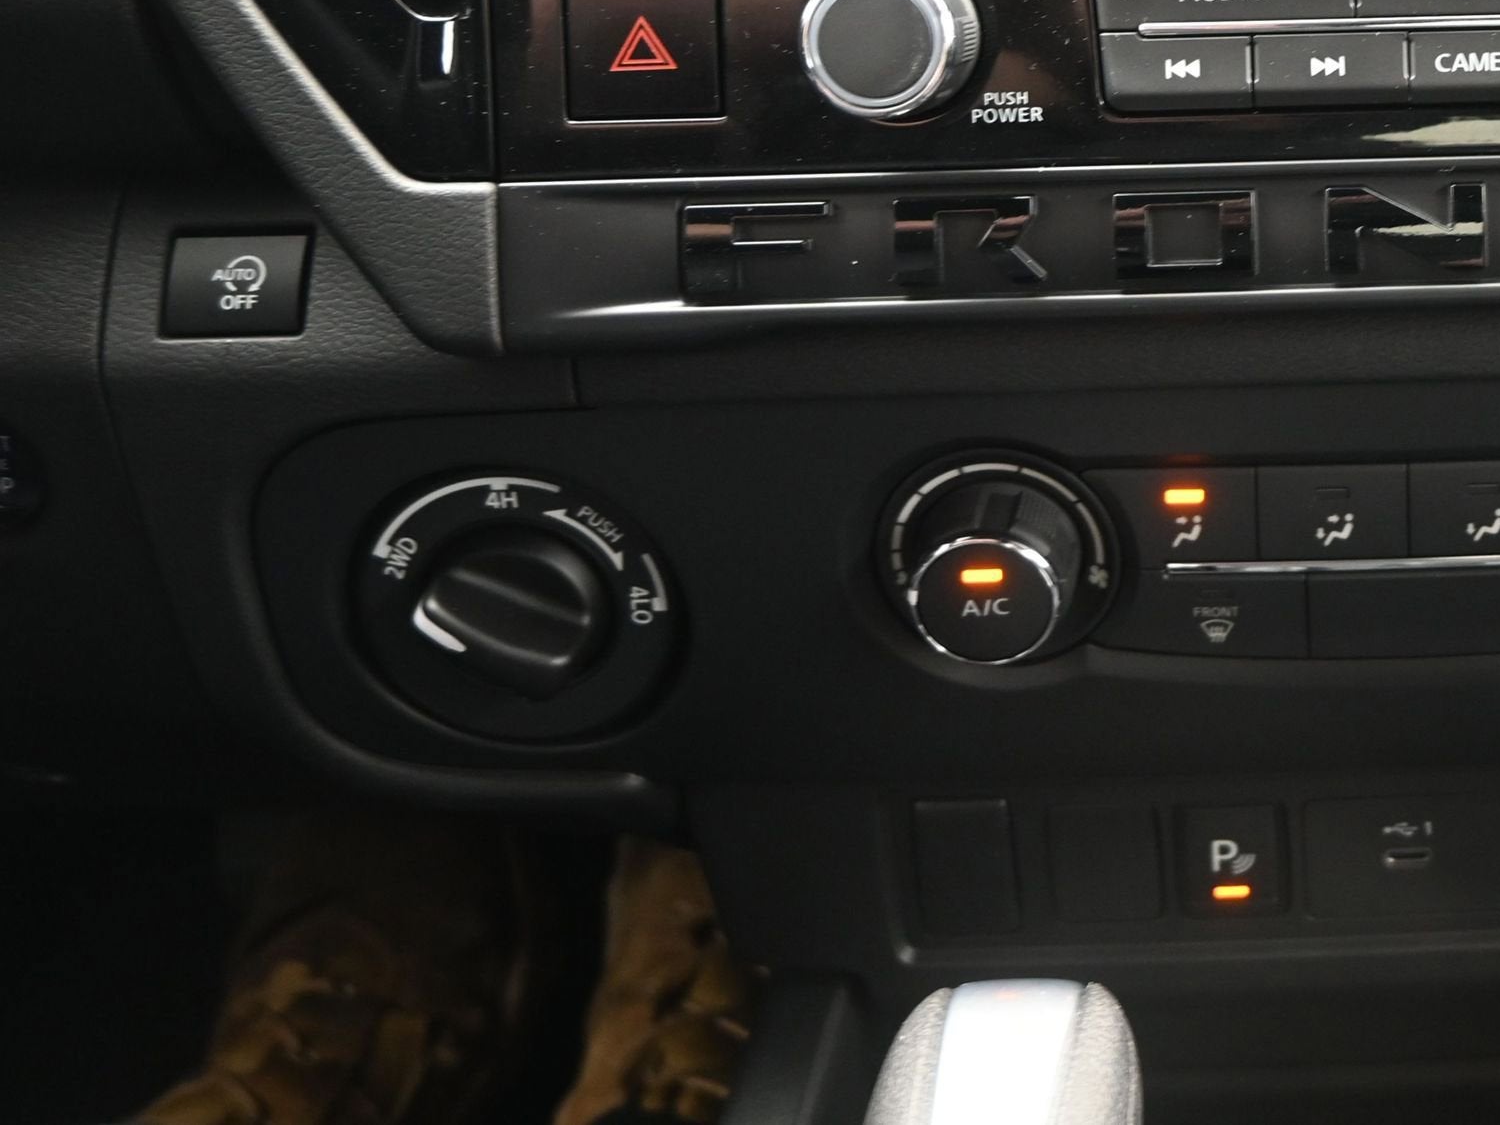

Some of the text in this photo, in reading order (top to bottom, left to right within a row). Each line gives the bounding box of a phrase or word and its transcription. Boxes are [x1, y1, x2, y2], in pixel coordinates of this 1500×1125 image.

[983, 91, 1030, 107] PUSH
[971, 106, 1044, 124] POWER
[211, 268, 257, 282] AUTO
[219, 294, 260, 310] OFF
[484, 492, 519, 509] 4H
[576, 505, 624, 544] PUSH
[383, 536, 419, 580] 2WD
[629, 586, 653, 625] 4LO
[961, 597, 1011, 618] A/C
[1192, 606, 1239, 617] FRONT
[1210, 839, 1240, 873] P
